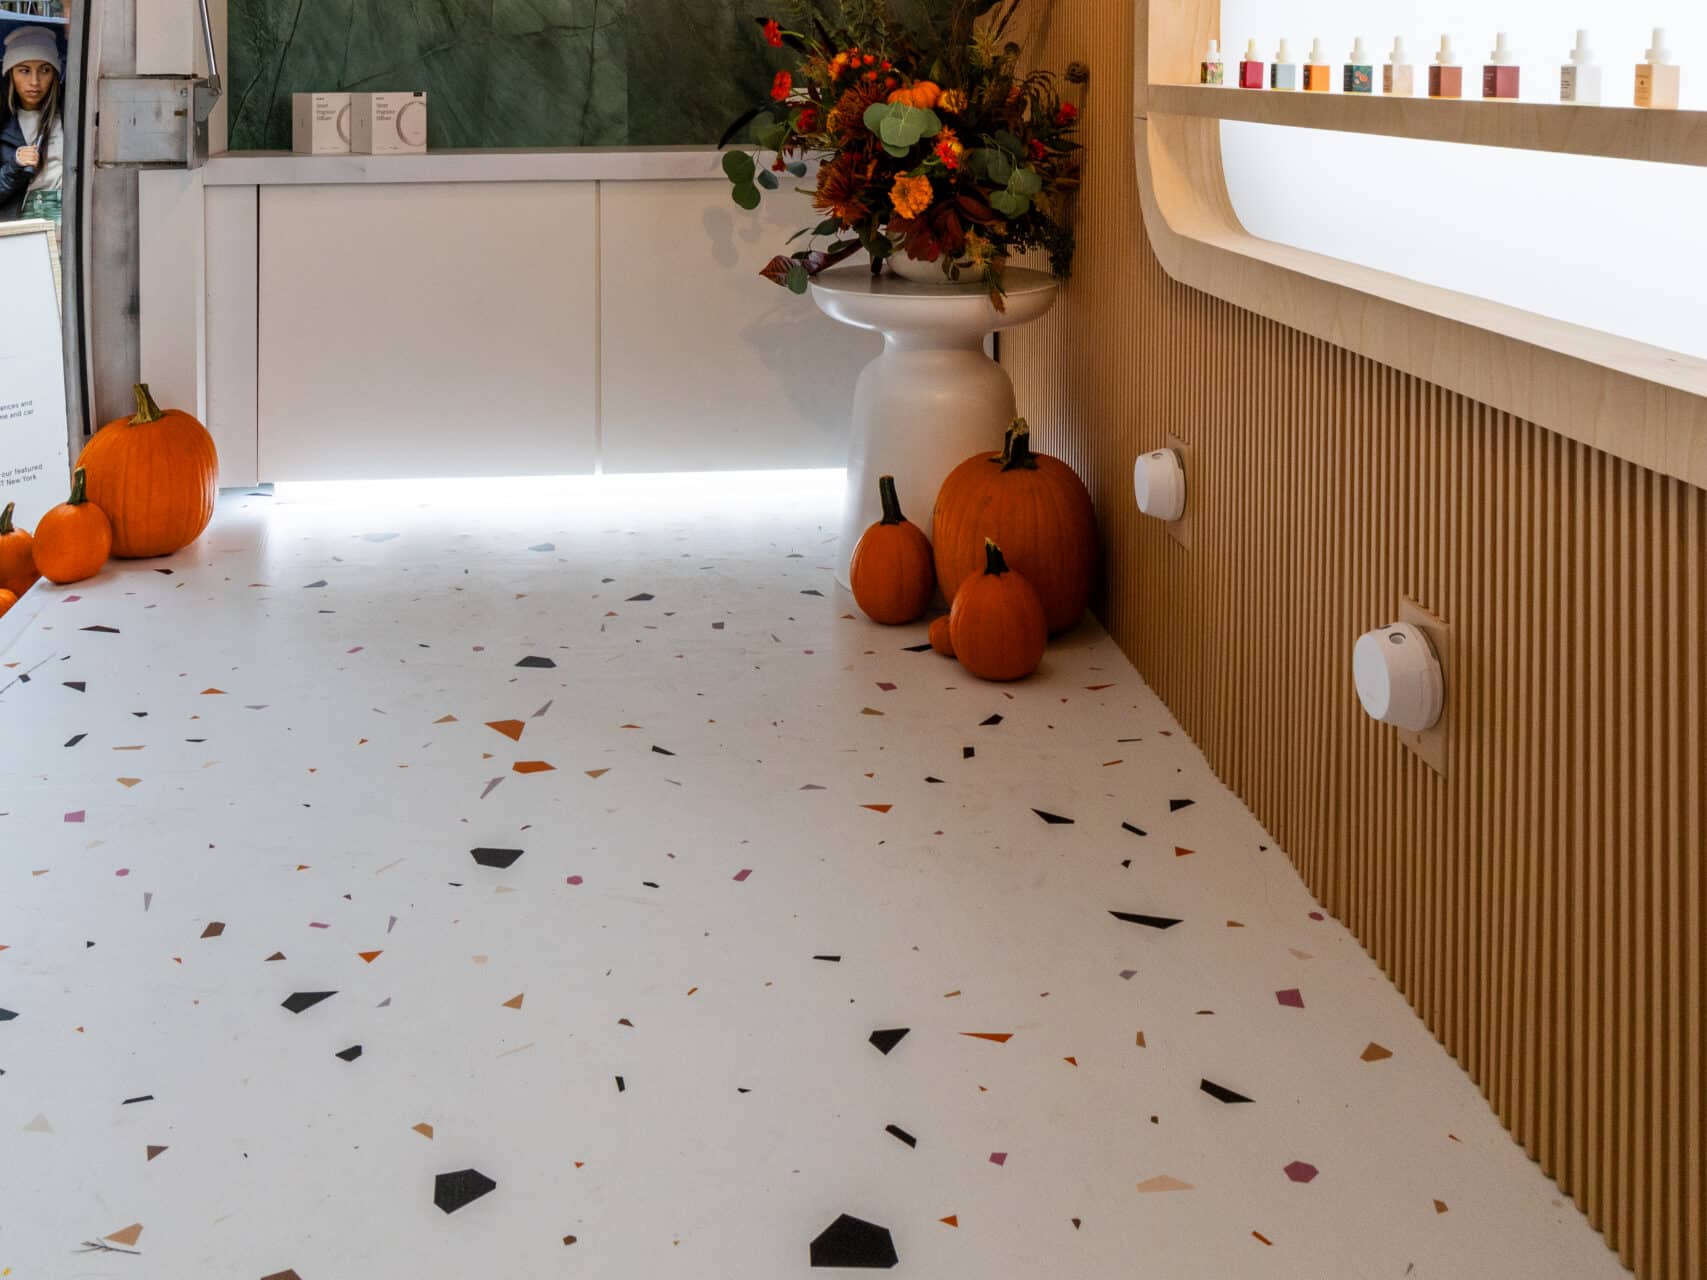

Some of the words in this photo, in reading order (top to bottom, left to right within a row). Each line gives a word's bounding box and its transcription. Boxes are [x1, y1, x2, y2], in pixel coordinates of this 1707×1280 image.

[21, 399, 33, 408] and
[10, 410, 22, 419] and
[14, 463, 43, 475] featured
[23, 473, 37, 482] York
